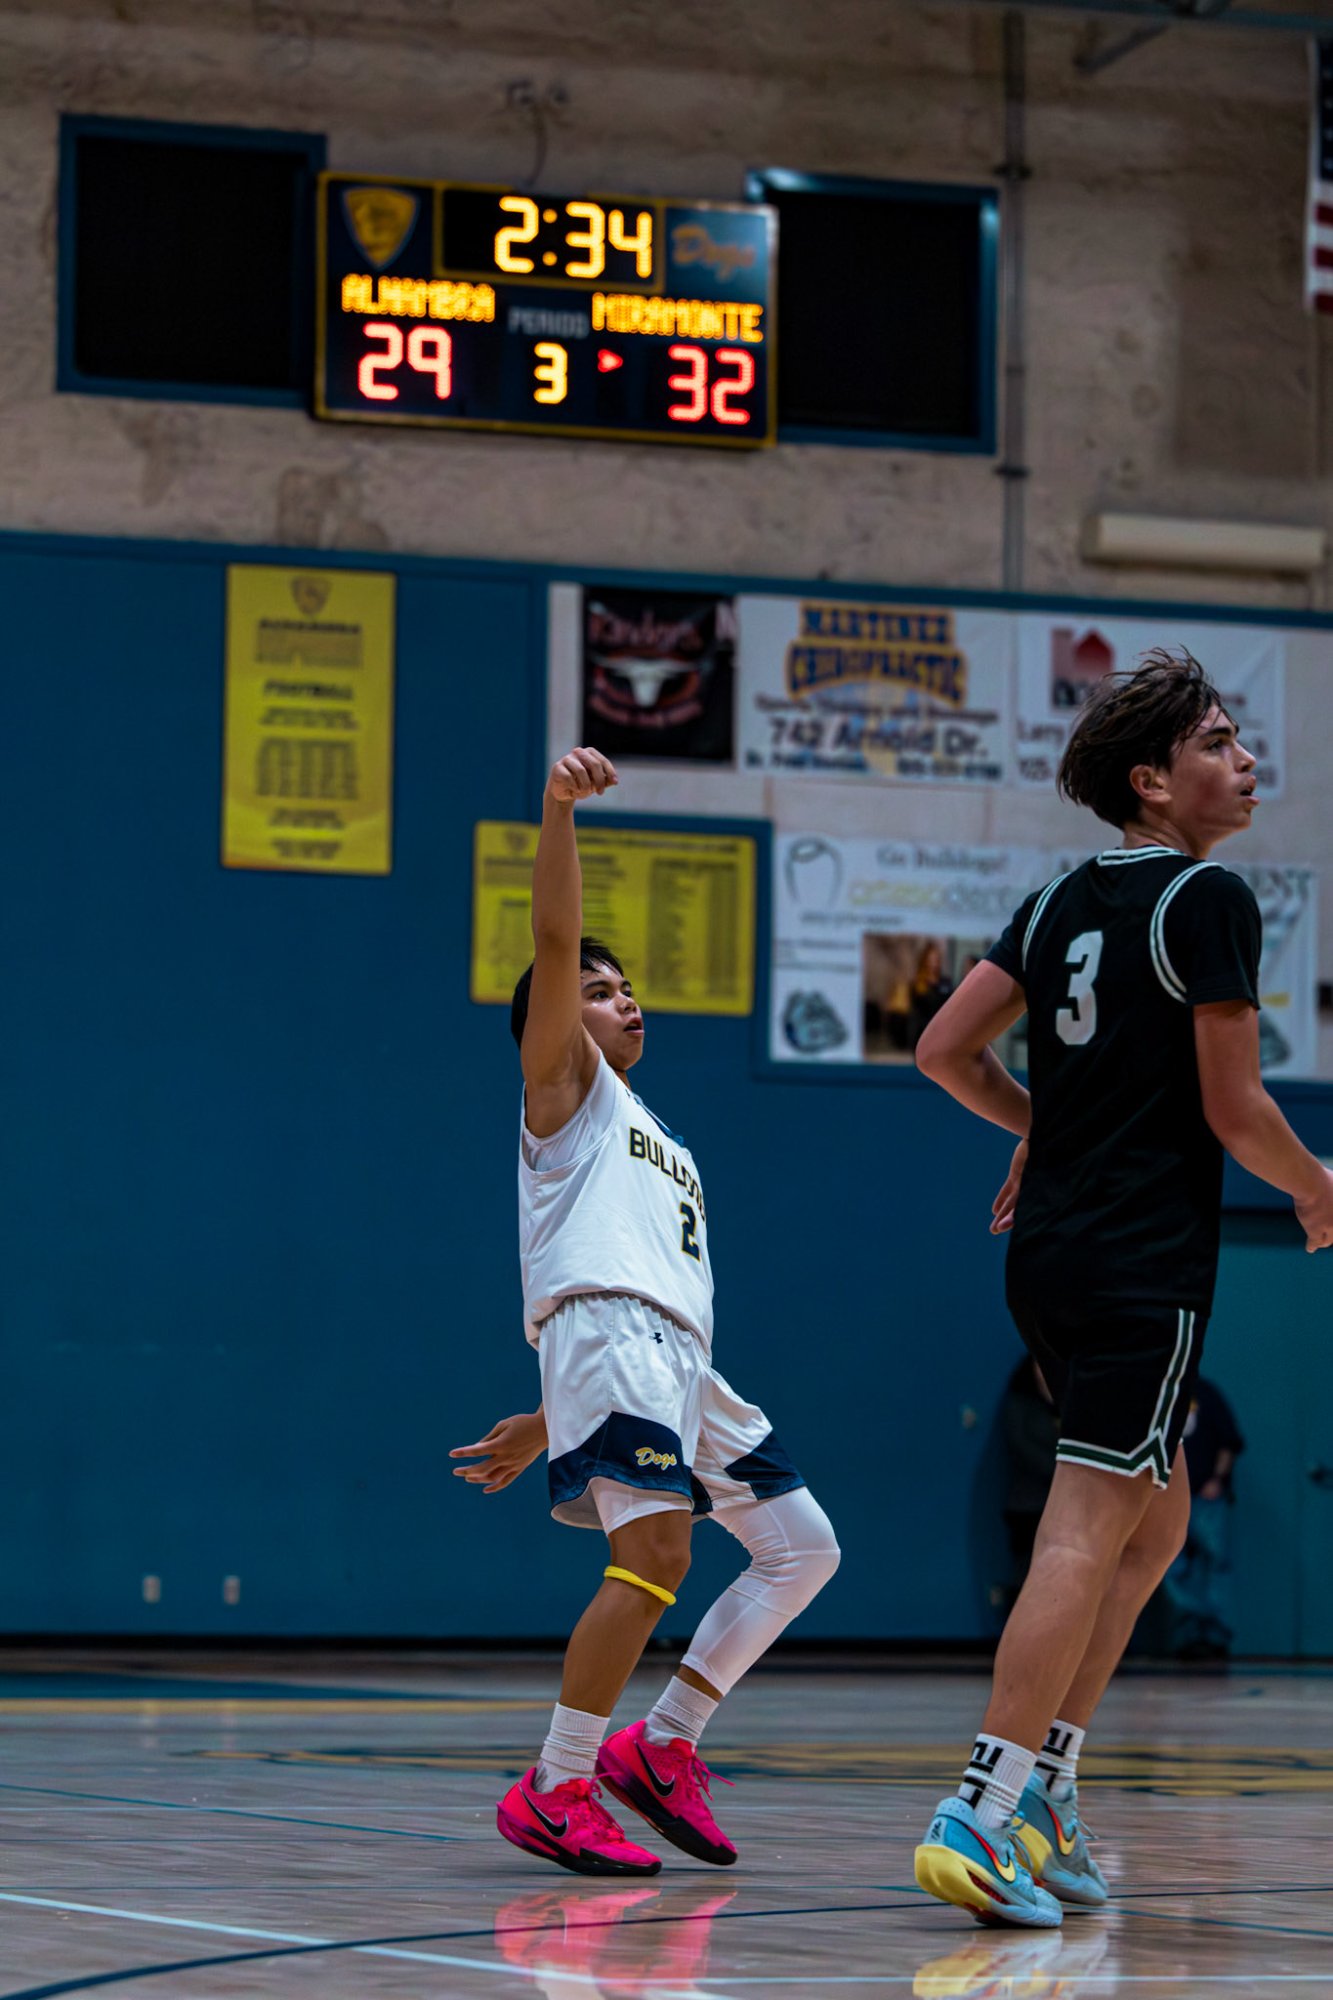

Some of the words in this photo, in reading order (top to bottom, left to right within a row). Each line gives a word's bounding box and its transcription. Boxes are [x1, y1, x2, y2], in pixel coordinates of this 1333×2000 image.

[494, 196, 653, 278] 2:34
[508, 305, 589, 340] PERIOD
[358, 322, 452, 401] 29
[533, 342, 568, 404] 3
[668, 344, 756, 426] 32
[1056, 930, 1104, 1045] 3
[680, 1202, 701, 1262] 2
[634, 1446, 677, 1471] Dogs
